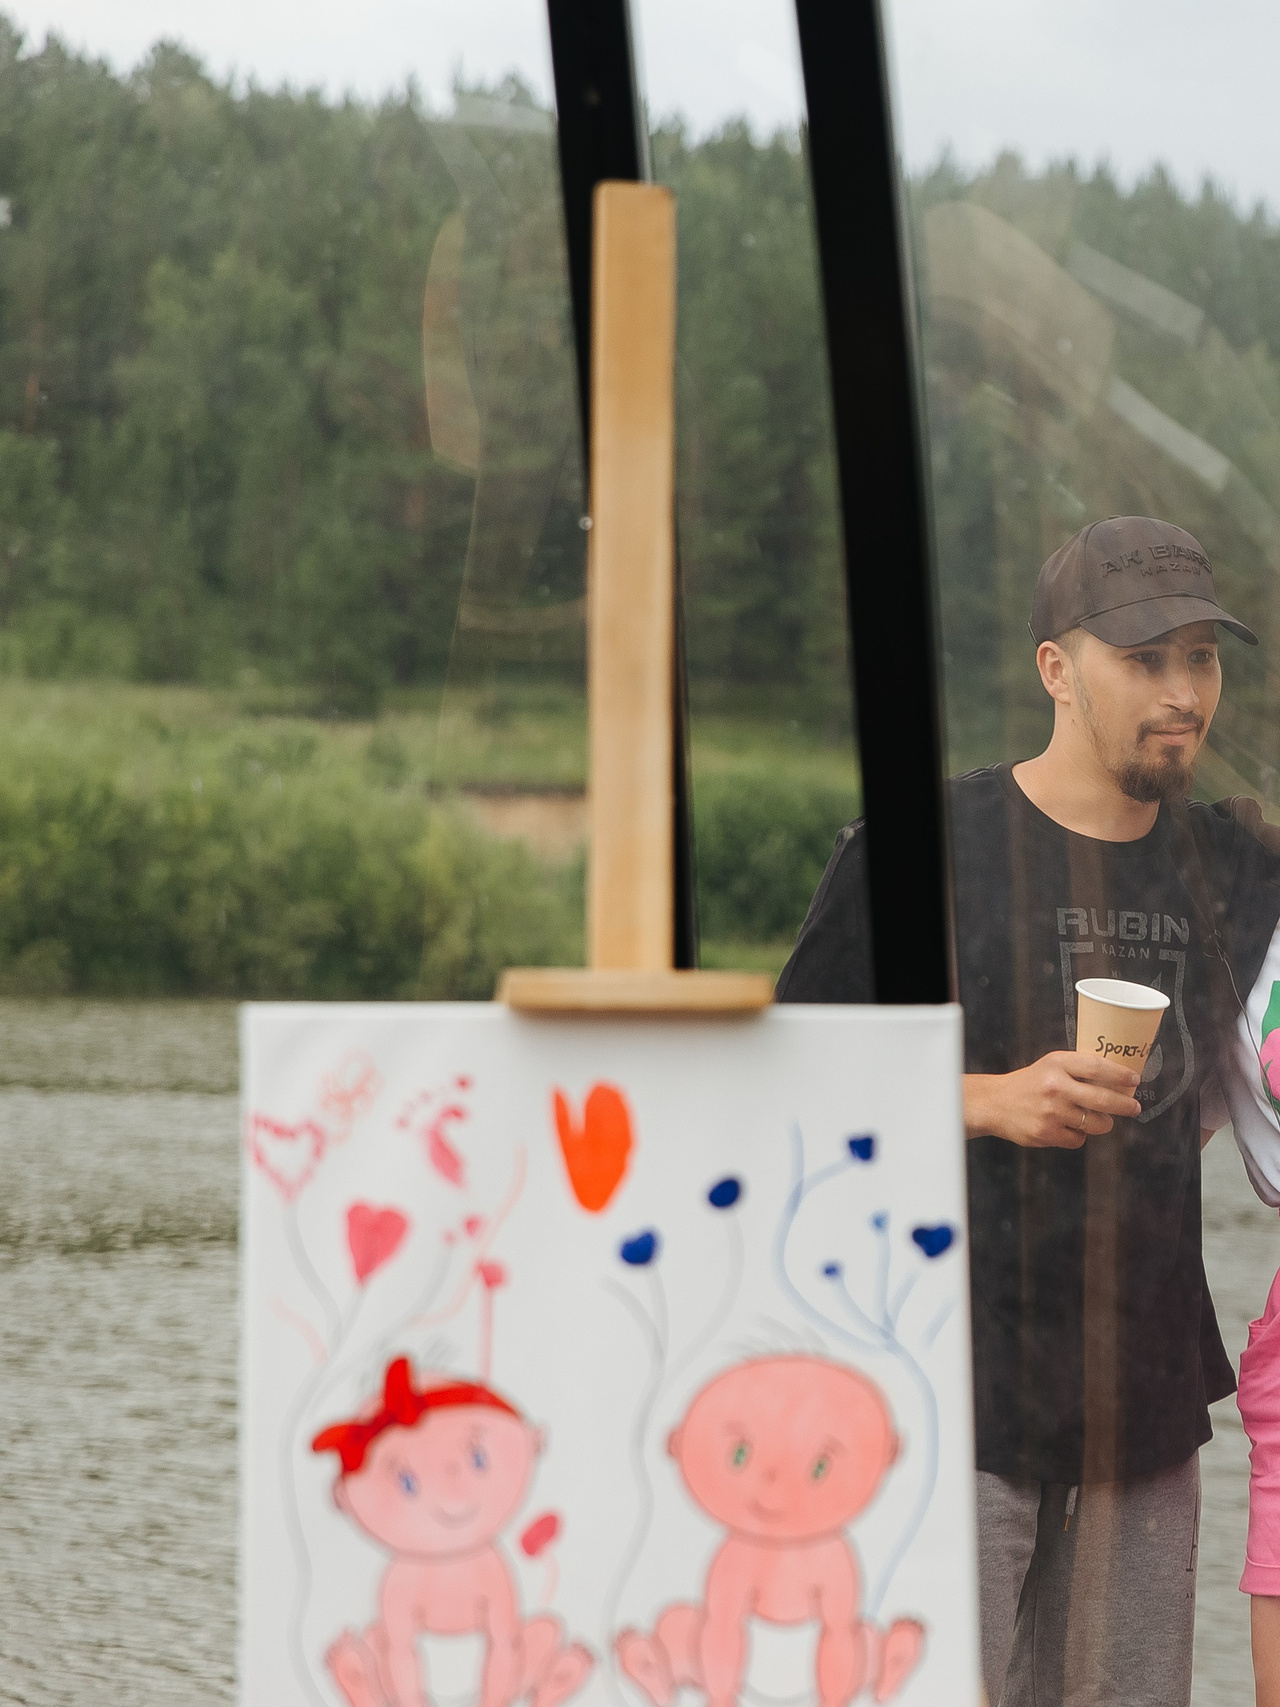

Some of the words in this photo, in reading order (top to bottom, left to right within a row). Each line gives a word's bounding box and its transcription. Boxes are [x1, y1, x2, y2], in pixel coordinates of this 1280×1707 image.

[1101, 550, 1143, 578] AK
[1056, 907, 1190, 945] RUBIN
[1101, 943, 1150, 960] KAZAN
[1135, 1090, 1156, 1101] 958
